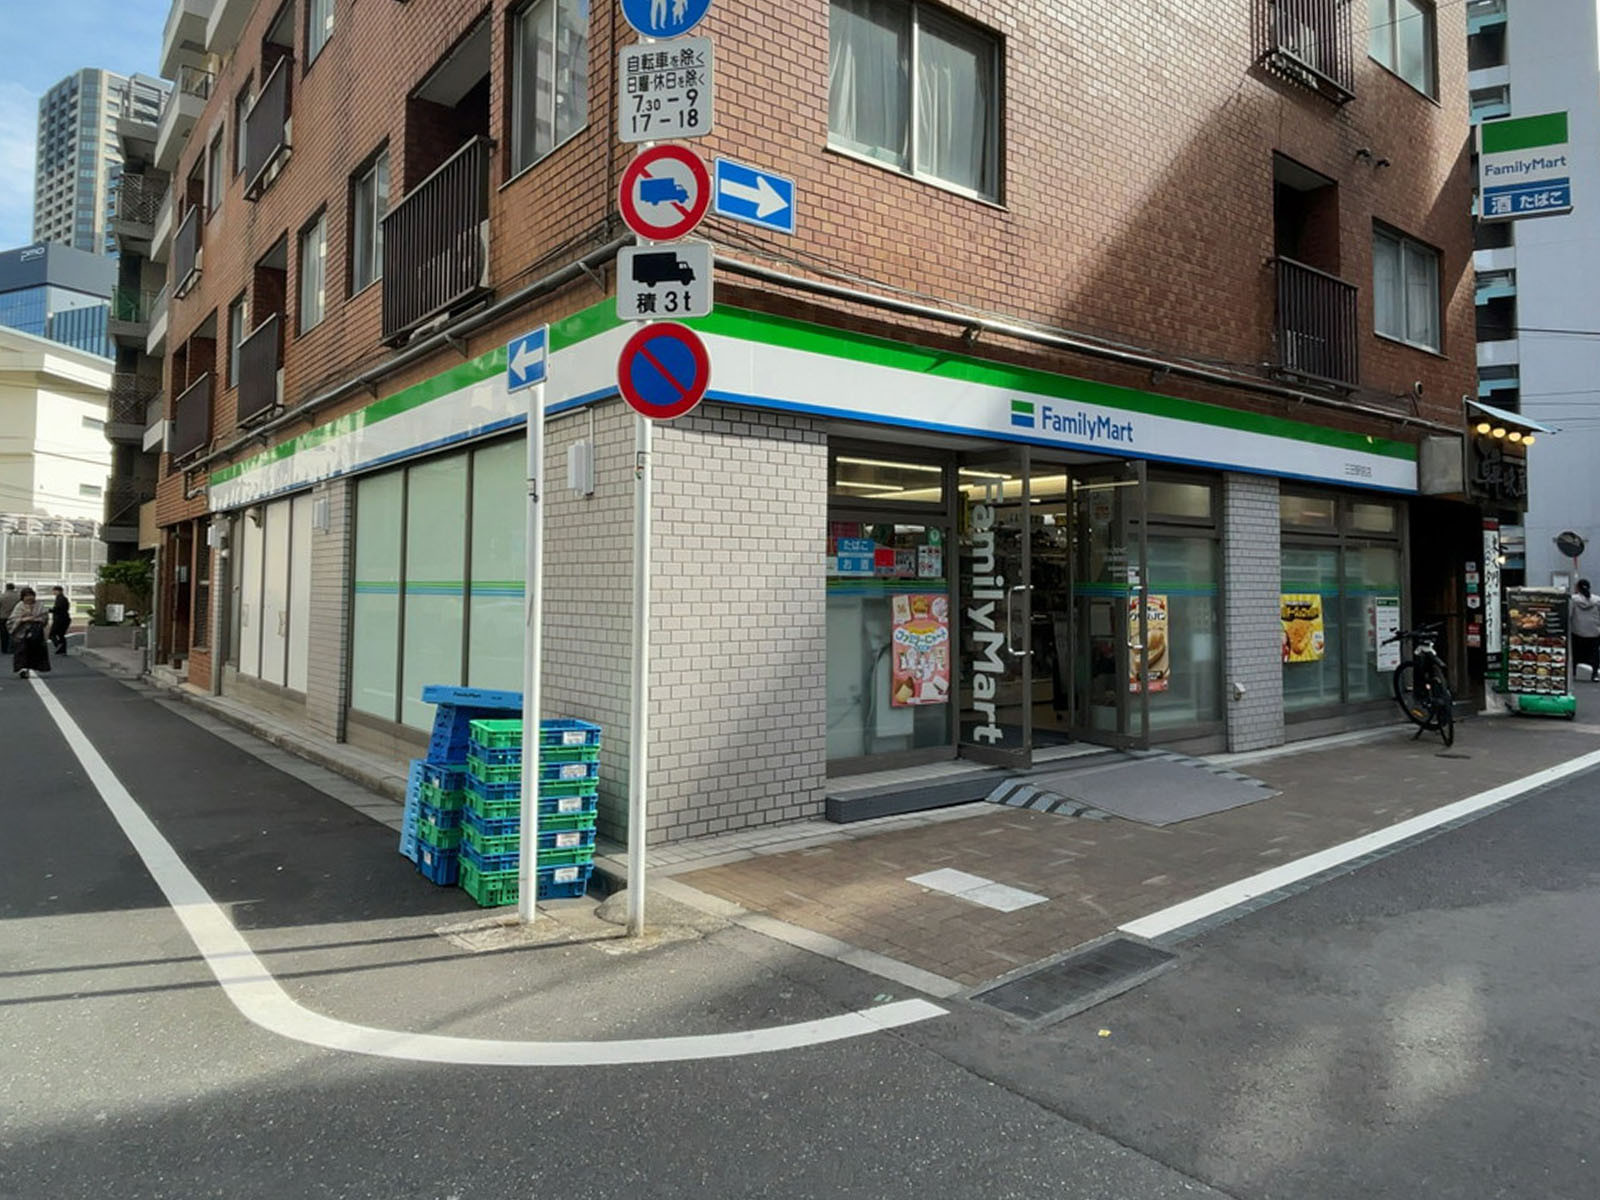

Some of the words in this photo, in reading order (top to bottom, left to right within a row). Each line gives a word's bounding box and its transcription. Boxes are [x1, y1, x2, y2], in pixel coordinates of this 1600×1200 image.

[627, 48, 705, 73] 自転車を除く
[1484, 156, 1567, 177] FamilyMart
[1491, 195, 1512, 214] 酒
[1519, 191, 1563, 210] たばこ
[1041, 405, 1134, 442] FamilyMart
[967, 477, 1005, 744] FamilyMart
